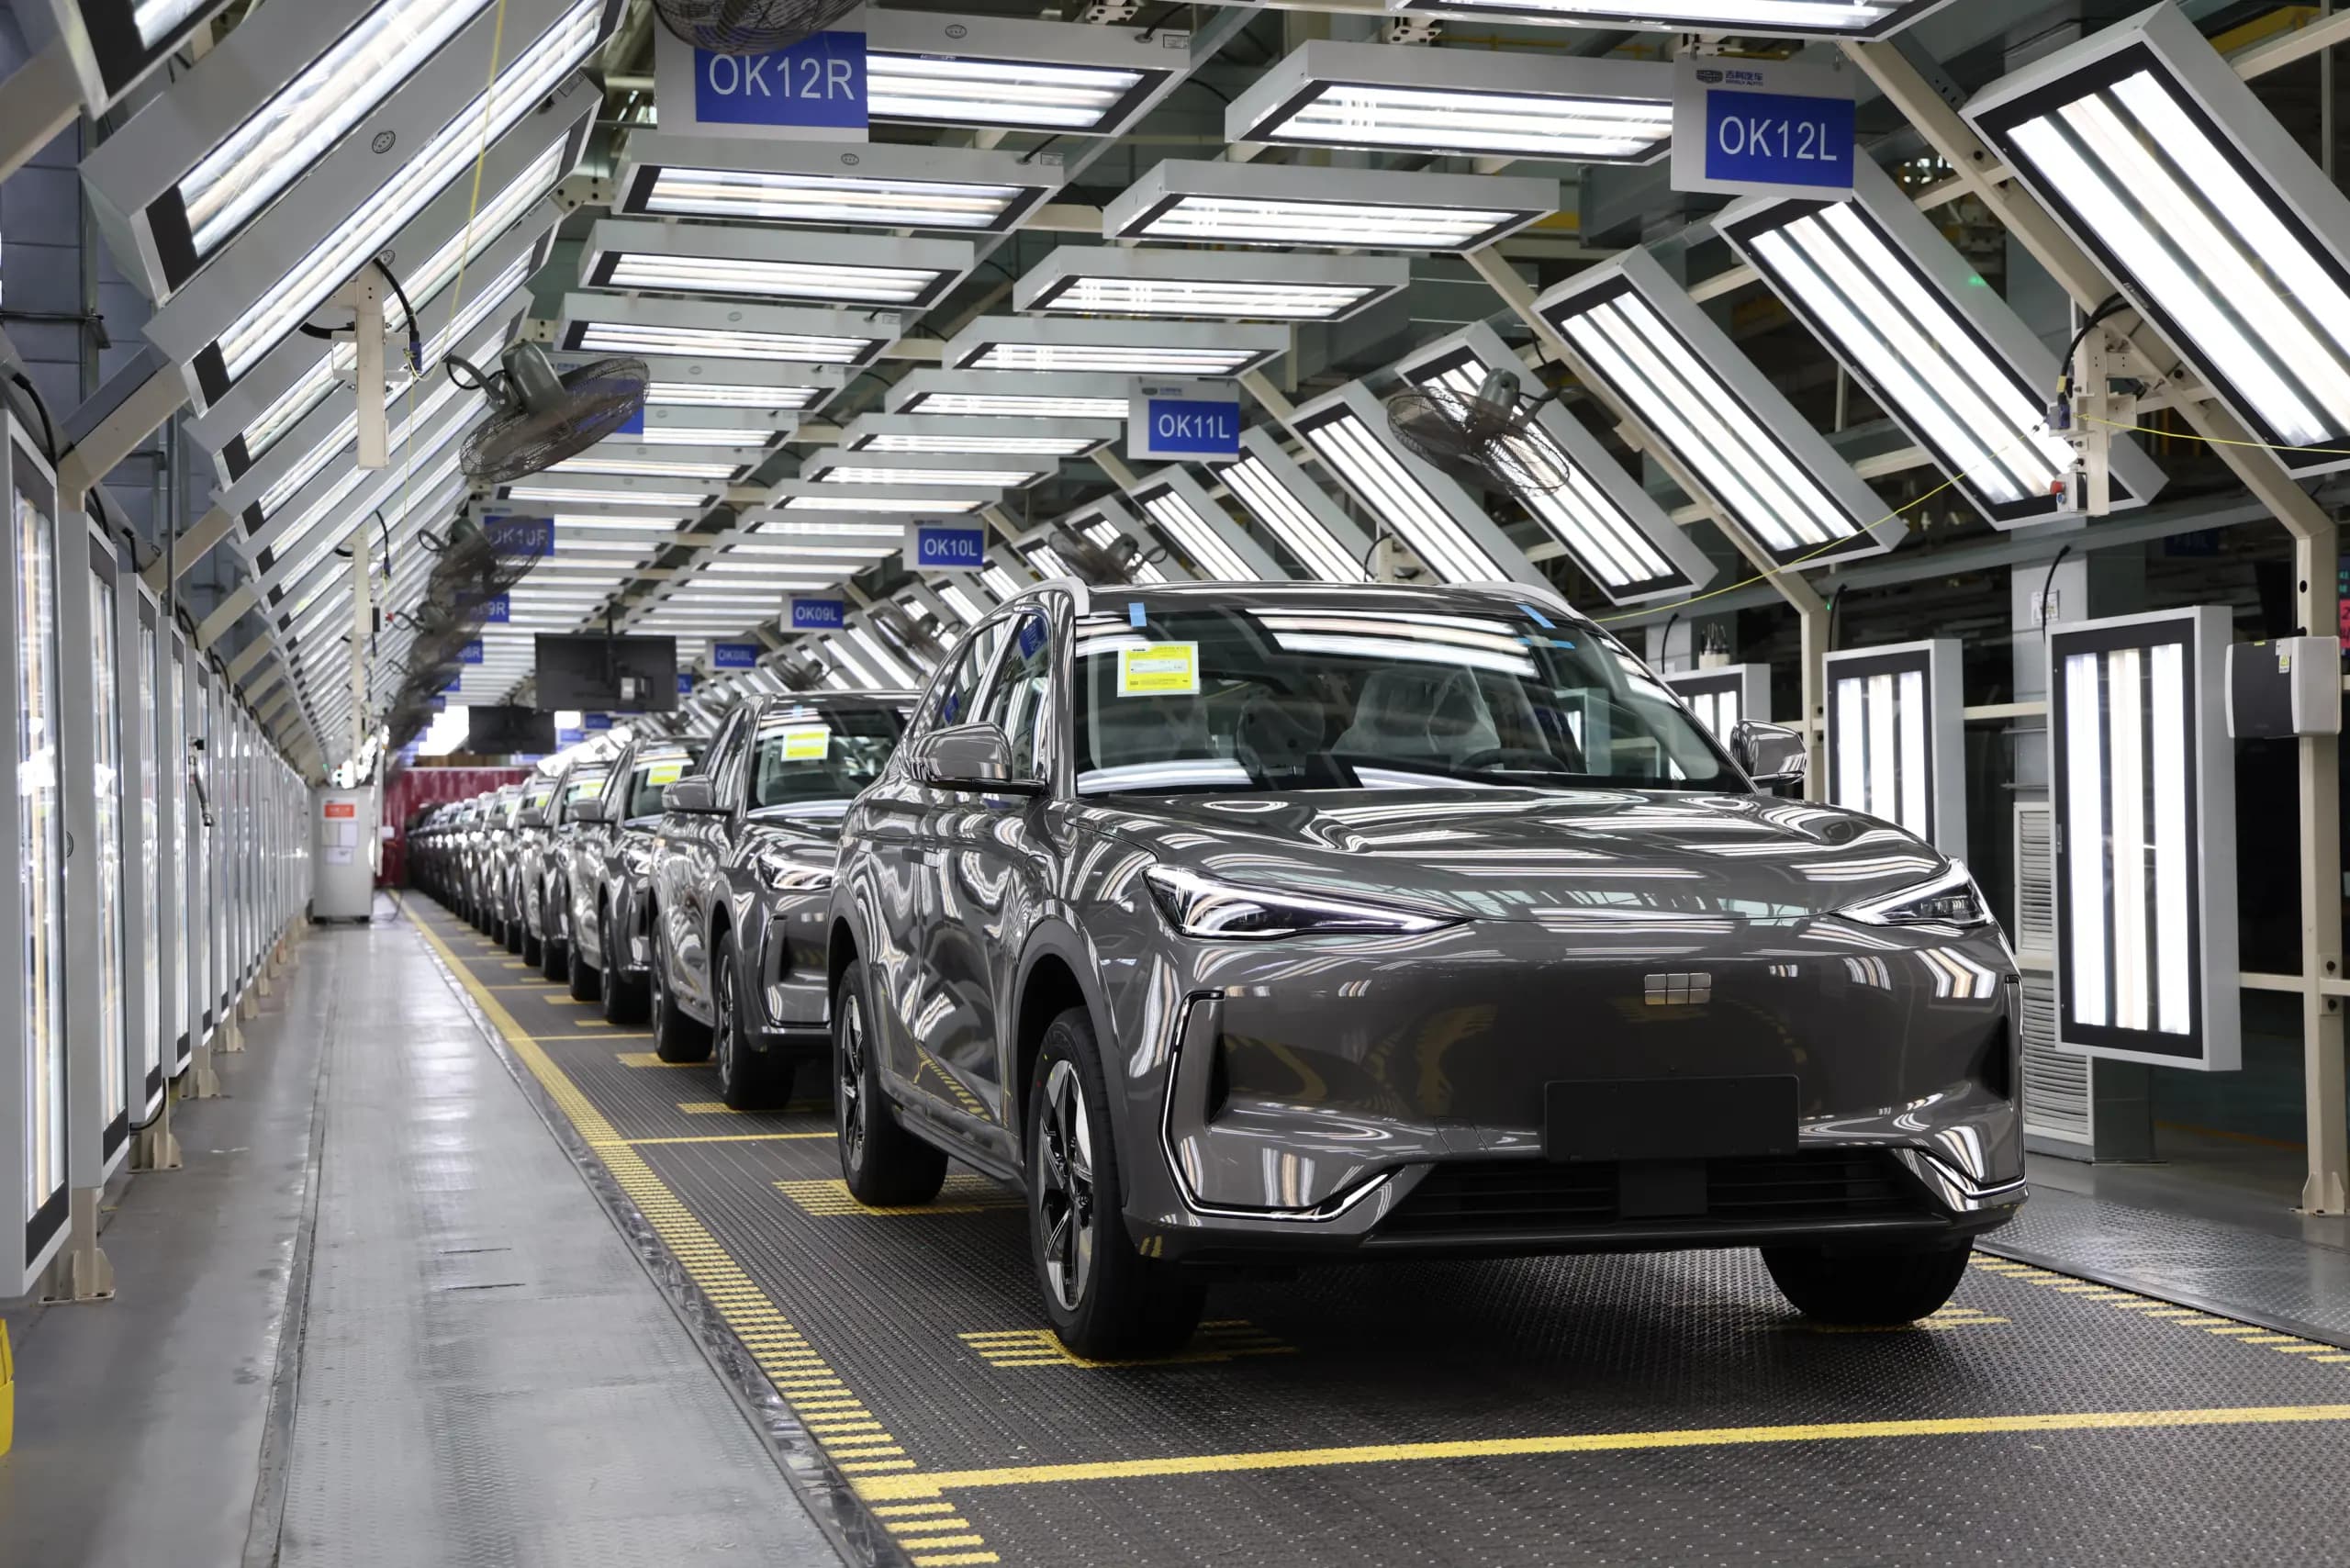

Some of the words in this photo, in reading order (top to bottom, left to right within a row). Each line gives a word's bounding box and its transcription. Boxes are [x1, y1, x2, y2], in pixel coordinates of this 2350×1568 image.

[709, 53, 855, 100] OK12R
[1718, 116, 1837, 162] OK12L
[1158, 414, 1230, 439] OK11L
[924, 538, 978, 557] OK10L
[795, 606, 837, 622] OK09L
